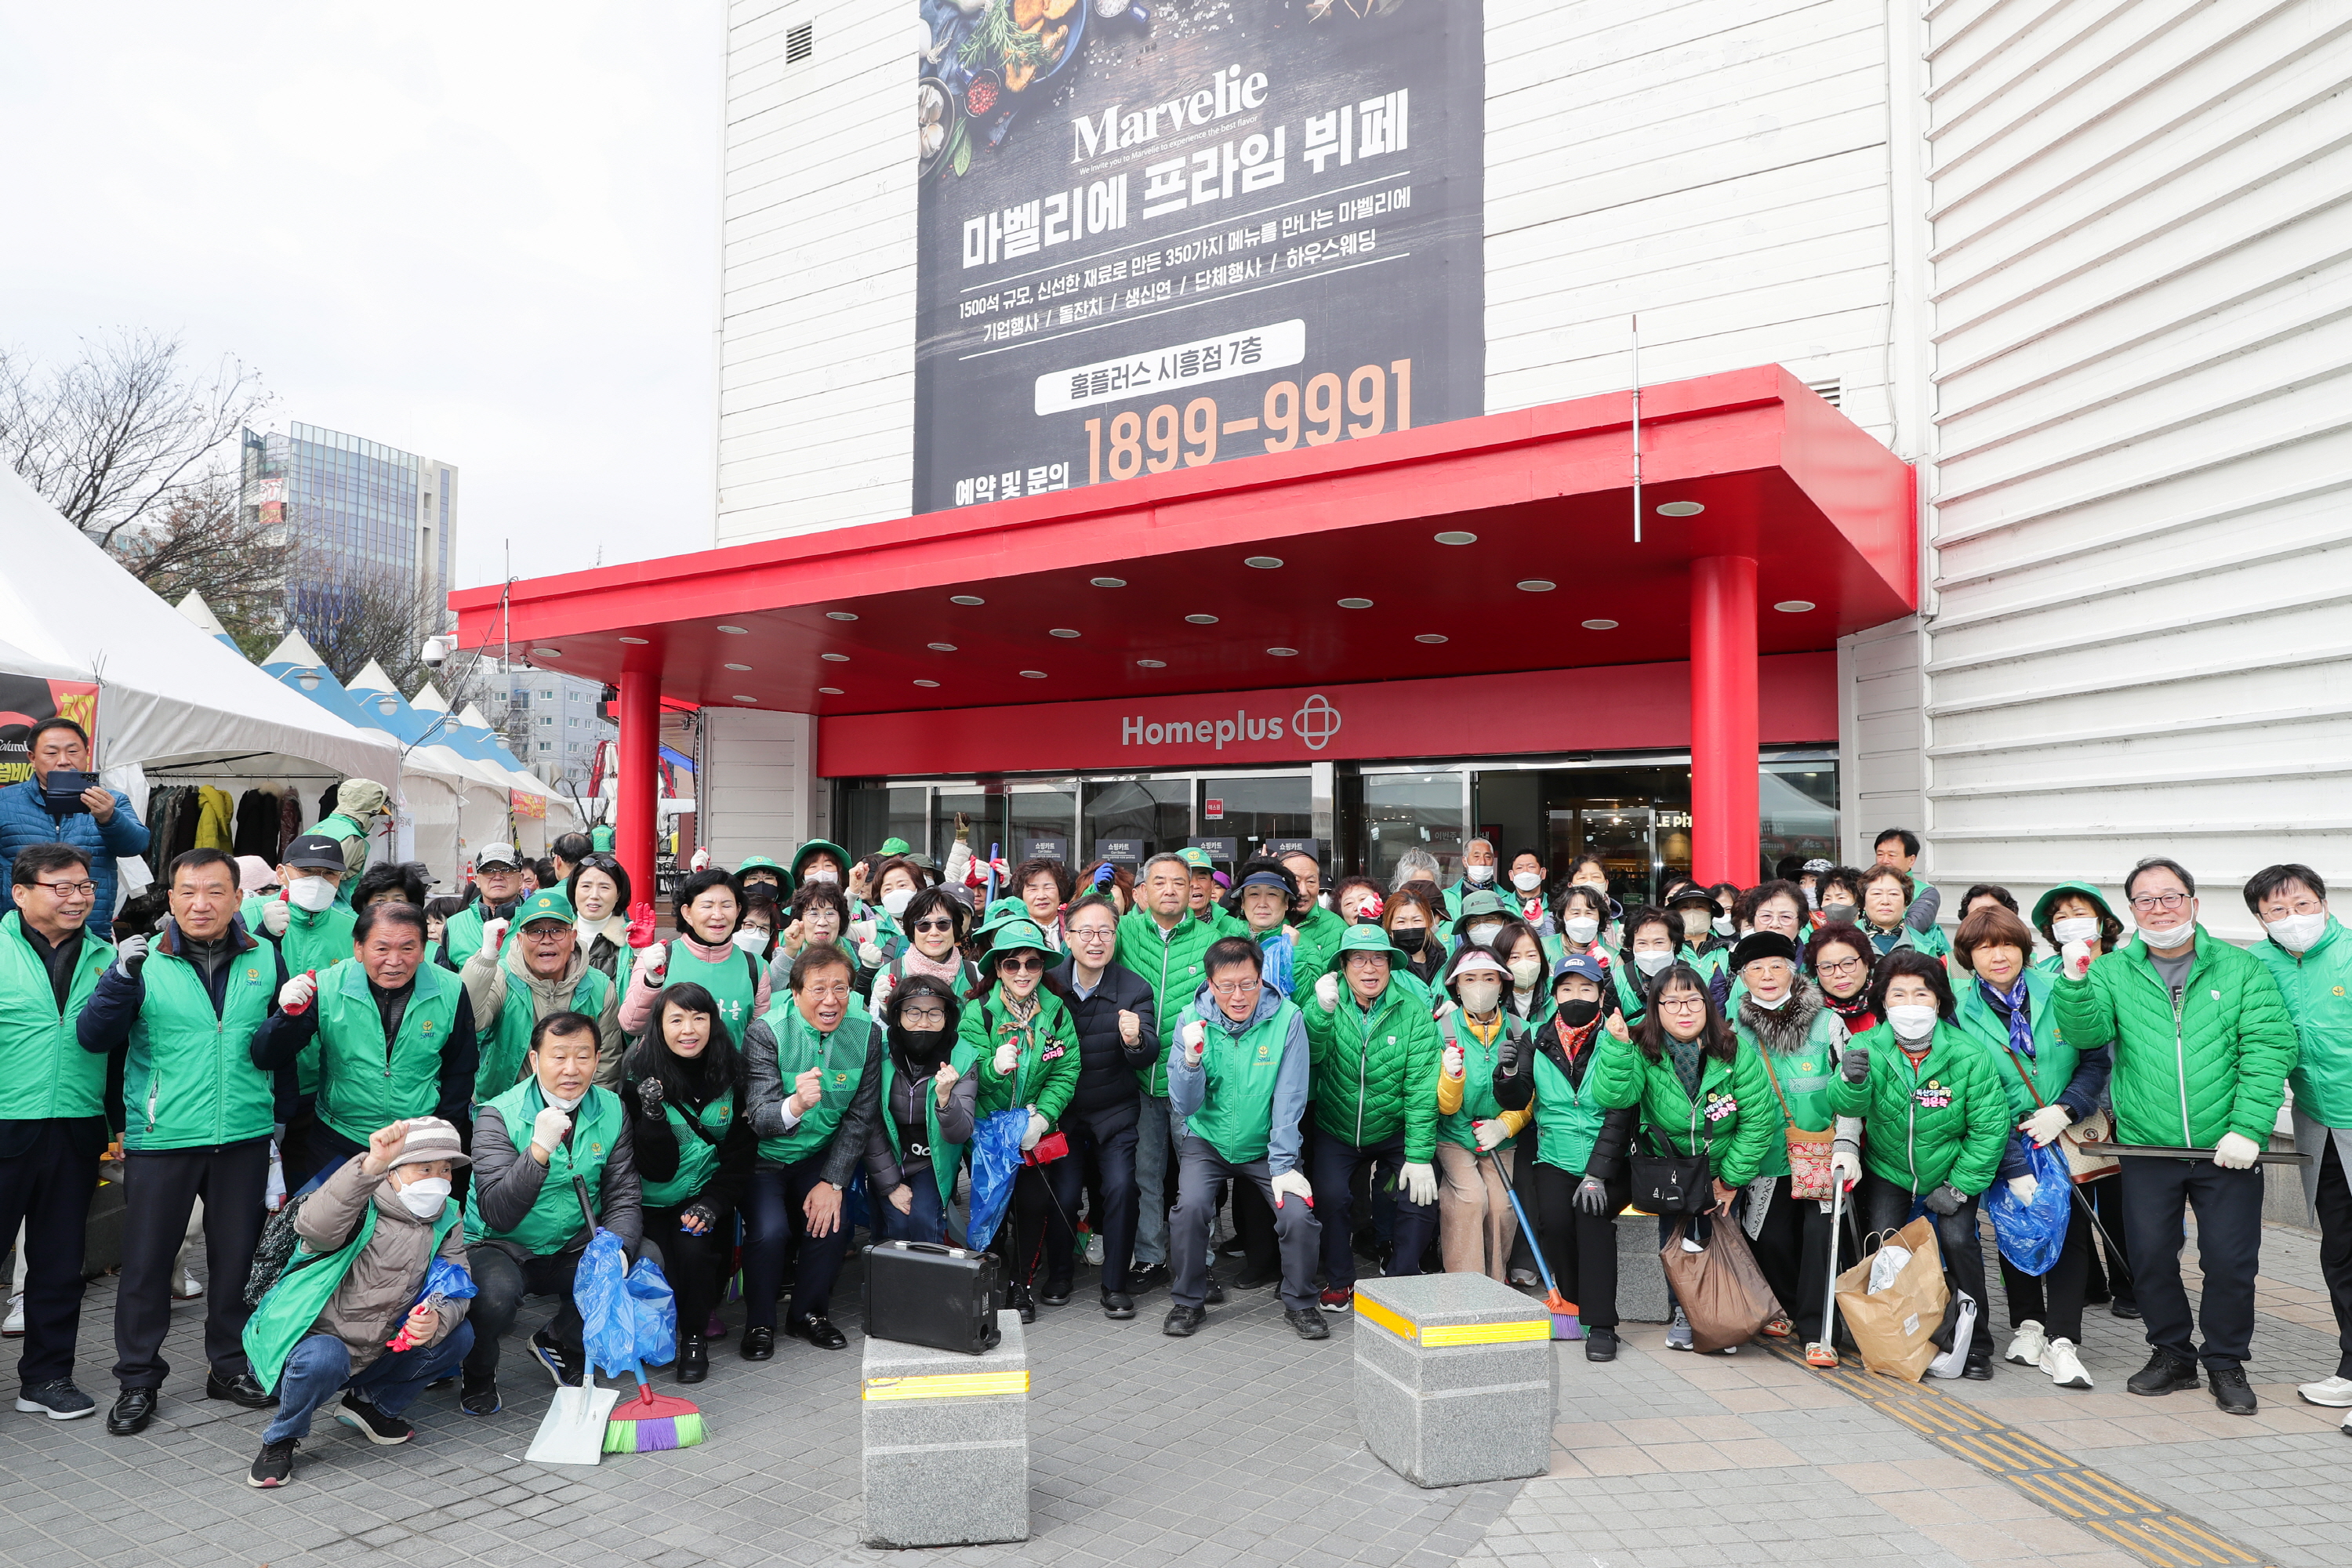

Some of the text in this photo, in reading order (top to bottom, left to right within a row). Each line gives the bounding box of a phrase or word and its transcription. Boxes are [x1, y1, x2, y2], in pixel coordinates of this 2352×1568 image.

[1070, 64, 1269, 165] Marvelie
[1079, 166, 1091, 176] We
[1109, 158, 1122, 169] you
[1123, 154, 1131, 162] to
[1131, 146, 1160, 159] Marvelie
[1160, 143, 1169, 151] to
[1169, 130, 1207, 150] experience
[1207, 125, 1221, 136] the
[1221, 122, 1236, 132] best
[1237, 115, 1258, 128] flavor
[962, 88, 1409, 269] 마벨리에 프라임 뷔페
[959, 185, 1411, 319] 1500석 규모, 신선한 재료로 만든 350가지 메뉴를 만나는 마벨리에
[983, 312, 1040, 342] 기업행사
[1058, 296, 1103, 325] 돌잔치
[1125, 279, 1171, 309] 생신연
[1195, 256, 1262, 292] 단체행사
[1287, 228, 1377, 269] 하우스웨딩
[1070, 336, 1263, 401] 홈플러스 시흥점 7층
[955, 358, 1412, 506] 예약 및 문의 1899-9991
[1122, 710, 1284, 750] Homeplus
[1108, 843, 1130, 851] 쇼핑카트
[1435, 831, 1457, 840] 이번주
